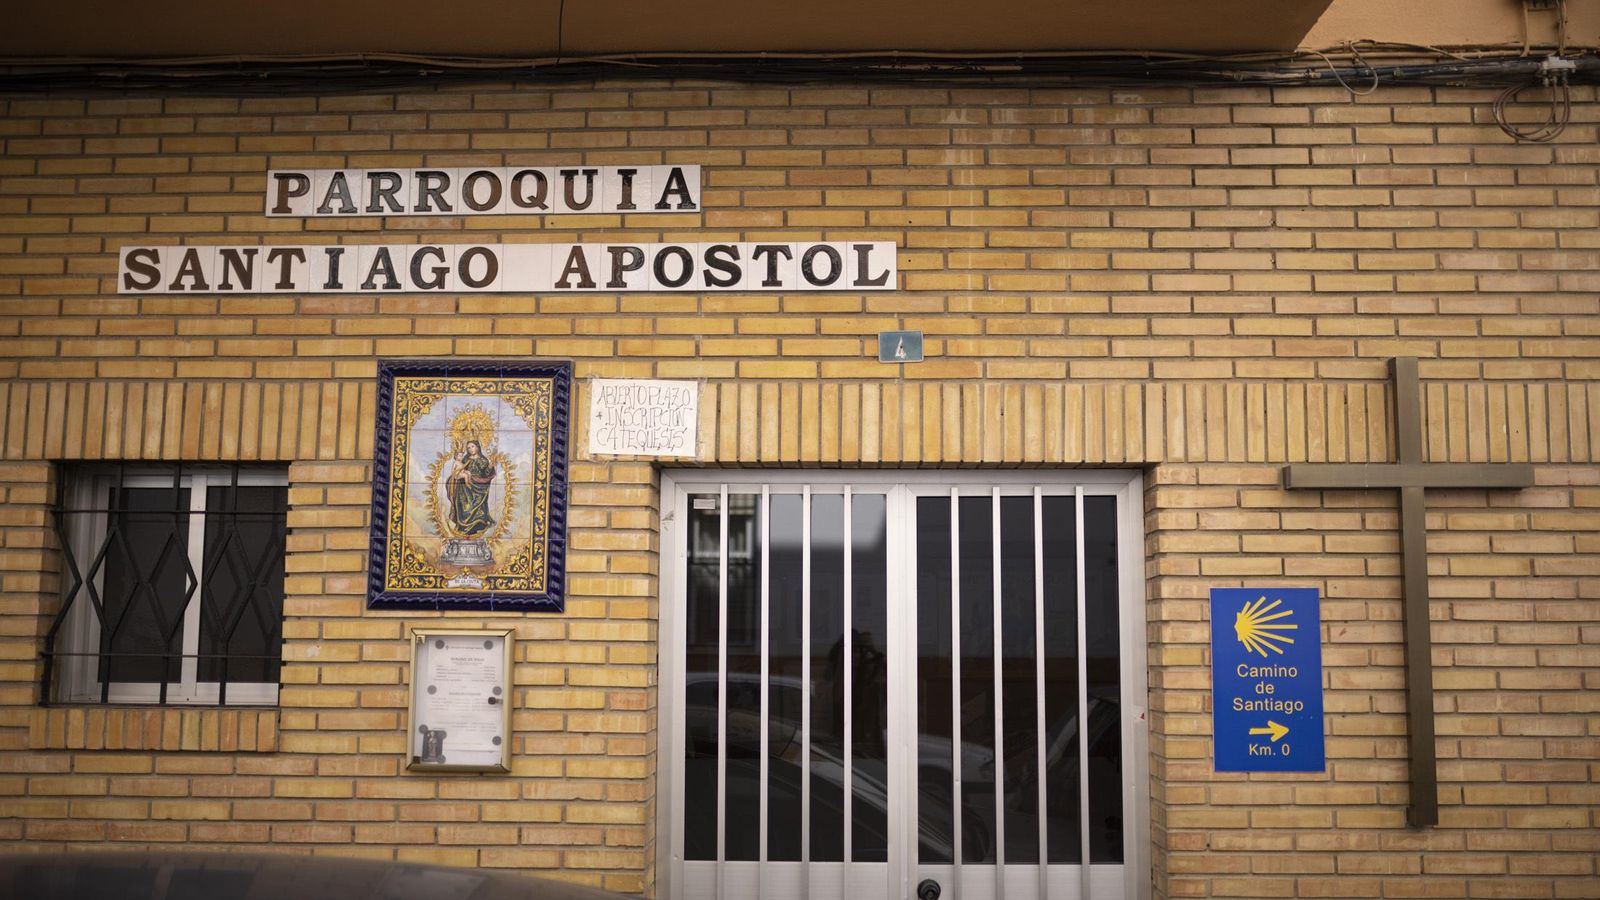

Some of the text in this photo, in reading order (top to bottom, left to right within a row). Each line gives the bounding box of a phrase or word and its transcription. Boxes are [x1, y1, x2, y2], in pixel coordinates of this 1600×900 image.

[271, 167, 697, 214] PARROQUIA
[123, 244, 891, 291] SANTIAGO APOSTOL
[597, 383, 691, 410] ABIERTO PLAZO
[1236, 663, 1298, 678] Camino
[1255, 681, 1275, 695] de
[1233, 697, 1304, 715] Santiago
[1249, 743, 1291, 756] Km. 0
